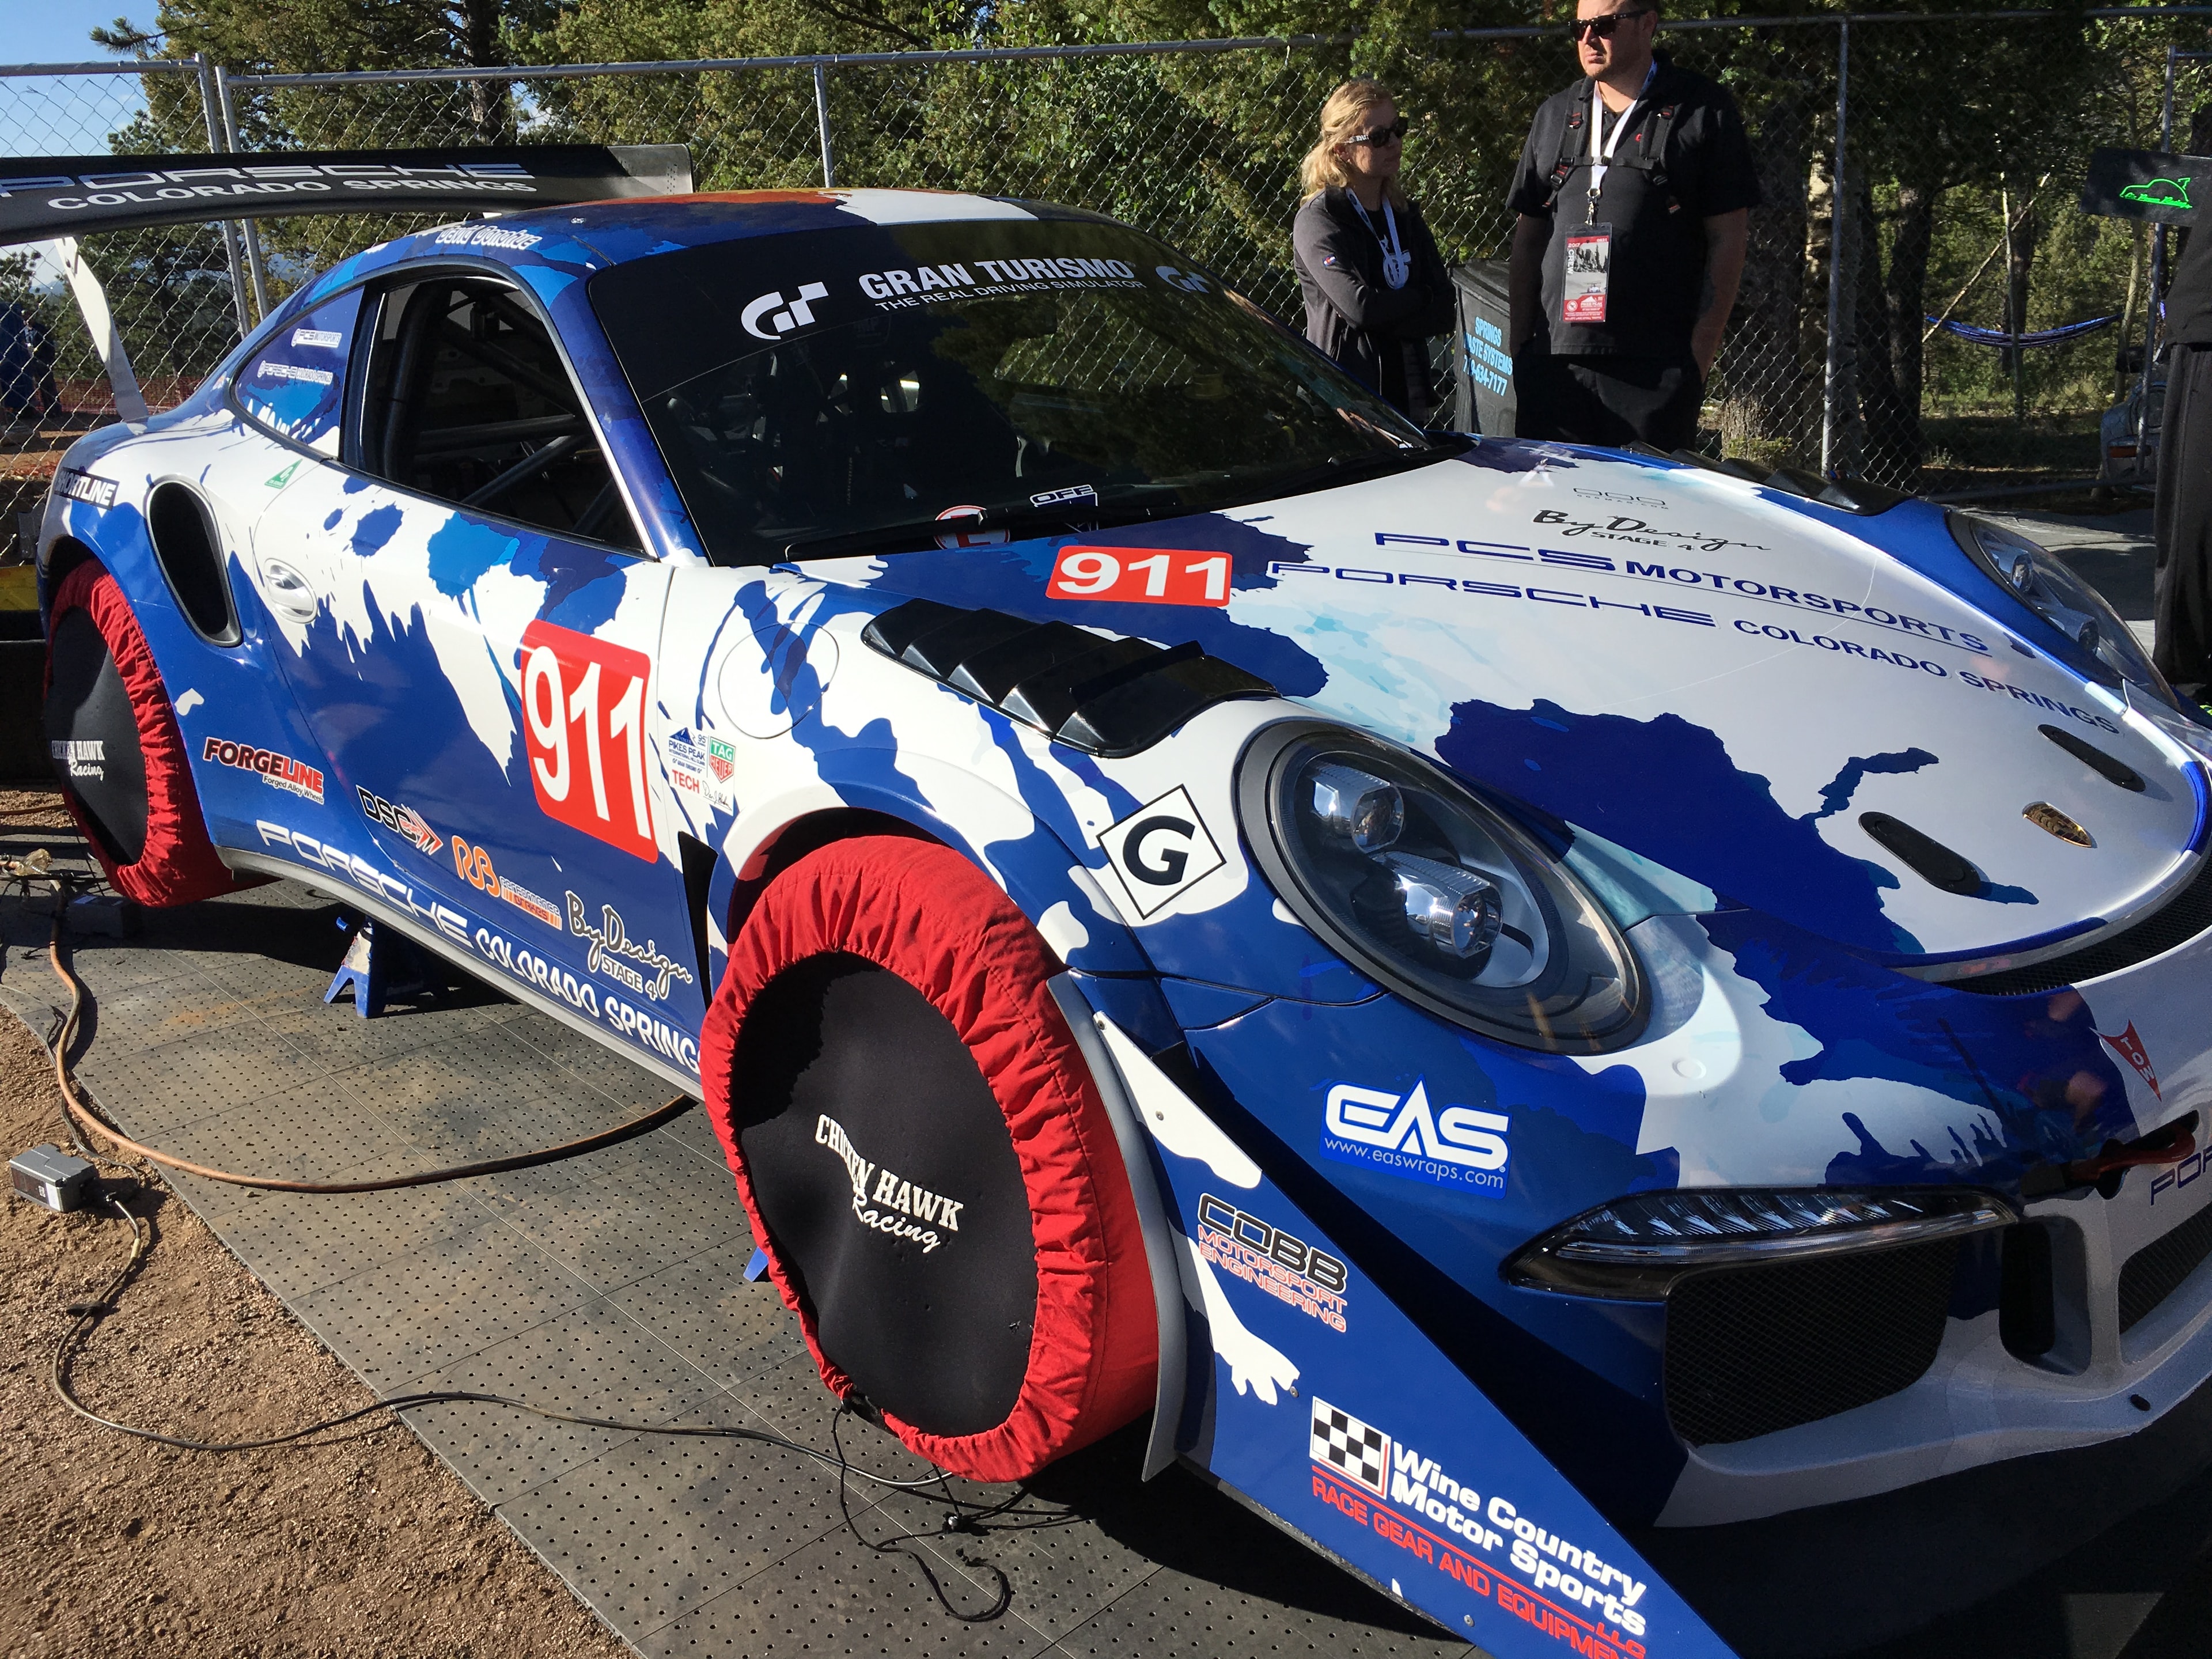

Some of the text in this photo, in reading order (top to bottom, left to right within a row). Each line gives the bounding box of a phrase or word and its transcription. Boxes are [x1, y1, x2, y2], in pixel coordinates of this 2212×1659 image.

[0, 164, 535, 197] PORSCHE
[48, 180, 537, 210] COLORADO SPRINGS
[859, 258, 1135, 300] GRAN TURISMO
[875, 280, 1147, 311] THE REAL DRIVING SIMULATOR
[1464, 332, 1513, 376] WASTE SYSTEMS
[1475, 317, 1502, 347] SPRINGS
[1463, 354, 1508, 396] 719-634-7177
[1032, 485, 1094, 503] OFF
[1591, 531, 1668, 547] STAGE
[1057, 552, 1227, 600] 911
[1374, 532, 1989, 652] PCS MOTORSPORTS
[1271, 562, 2120, 734] PORSCHE COLORADO SPRINGS
[76, 740, 105, 760] HAWK
[204, 737, 324, 794] FORGELINE
[525, 646, 652, 840] 911
[668, 740, 687, 753] PIKES
[688, 747, 706, 761] PEAK
[712, 741, 733, 761] TAG
[69, 757, 104, 781] Racing
[264, 775, 323, 804] Forged Alloy Wheels
[672, 769, 700, 794] TECH
[710, 755, 733, 781] HEUER
[356, 785, 418, 843] DSC
[400, 818, 422, 835] SPORT
[1123, 815, 1195, 886] G
[256, 819, 702, 1076] PORSCHE COLORADO SPRING
[601, 953, 658, 1001] STAGE 4
[2120, 1036, 2156, 1082] TOW
[1326, 1080, 1509, 1170] EAS
[815, 1114, 964, 1231] CHICKEN HAWK
[1324, 1137, 1504, 1189] www.easwraps.com
[852, 1184, 941, 1253] Racing
[1198, 1193, 1347, 1294] COBB
[1198, 1224, 1347, 1314] MOTORSPORT
[1198, 1240, 1347, 1332] ENGINEERING
[1312, 1475, 1368, 1527] RACE
[1373, 1513, 1433, 1564] GEAR
[1439, 1552, 1490, 1597] AND
[1393, 1441, 1647, 1606] Wine Country
[1391, 1471, 1646, 1635] Motor Sports
[1596, 1622, 1646, 1659] LLC
